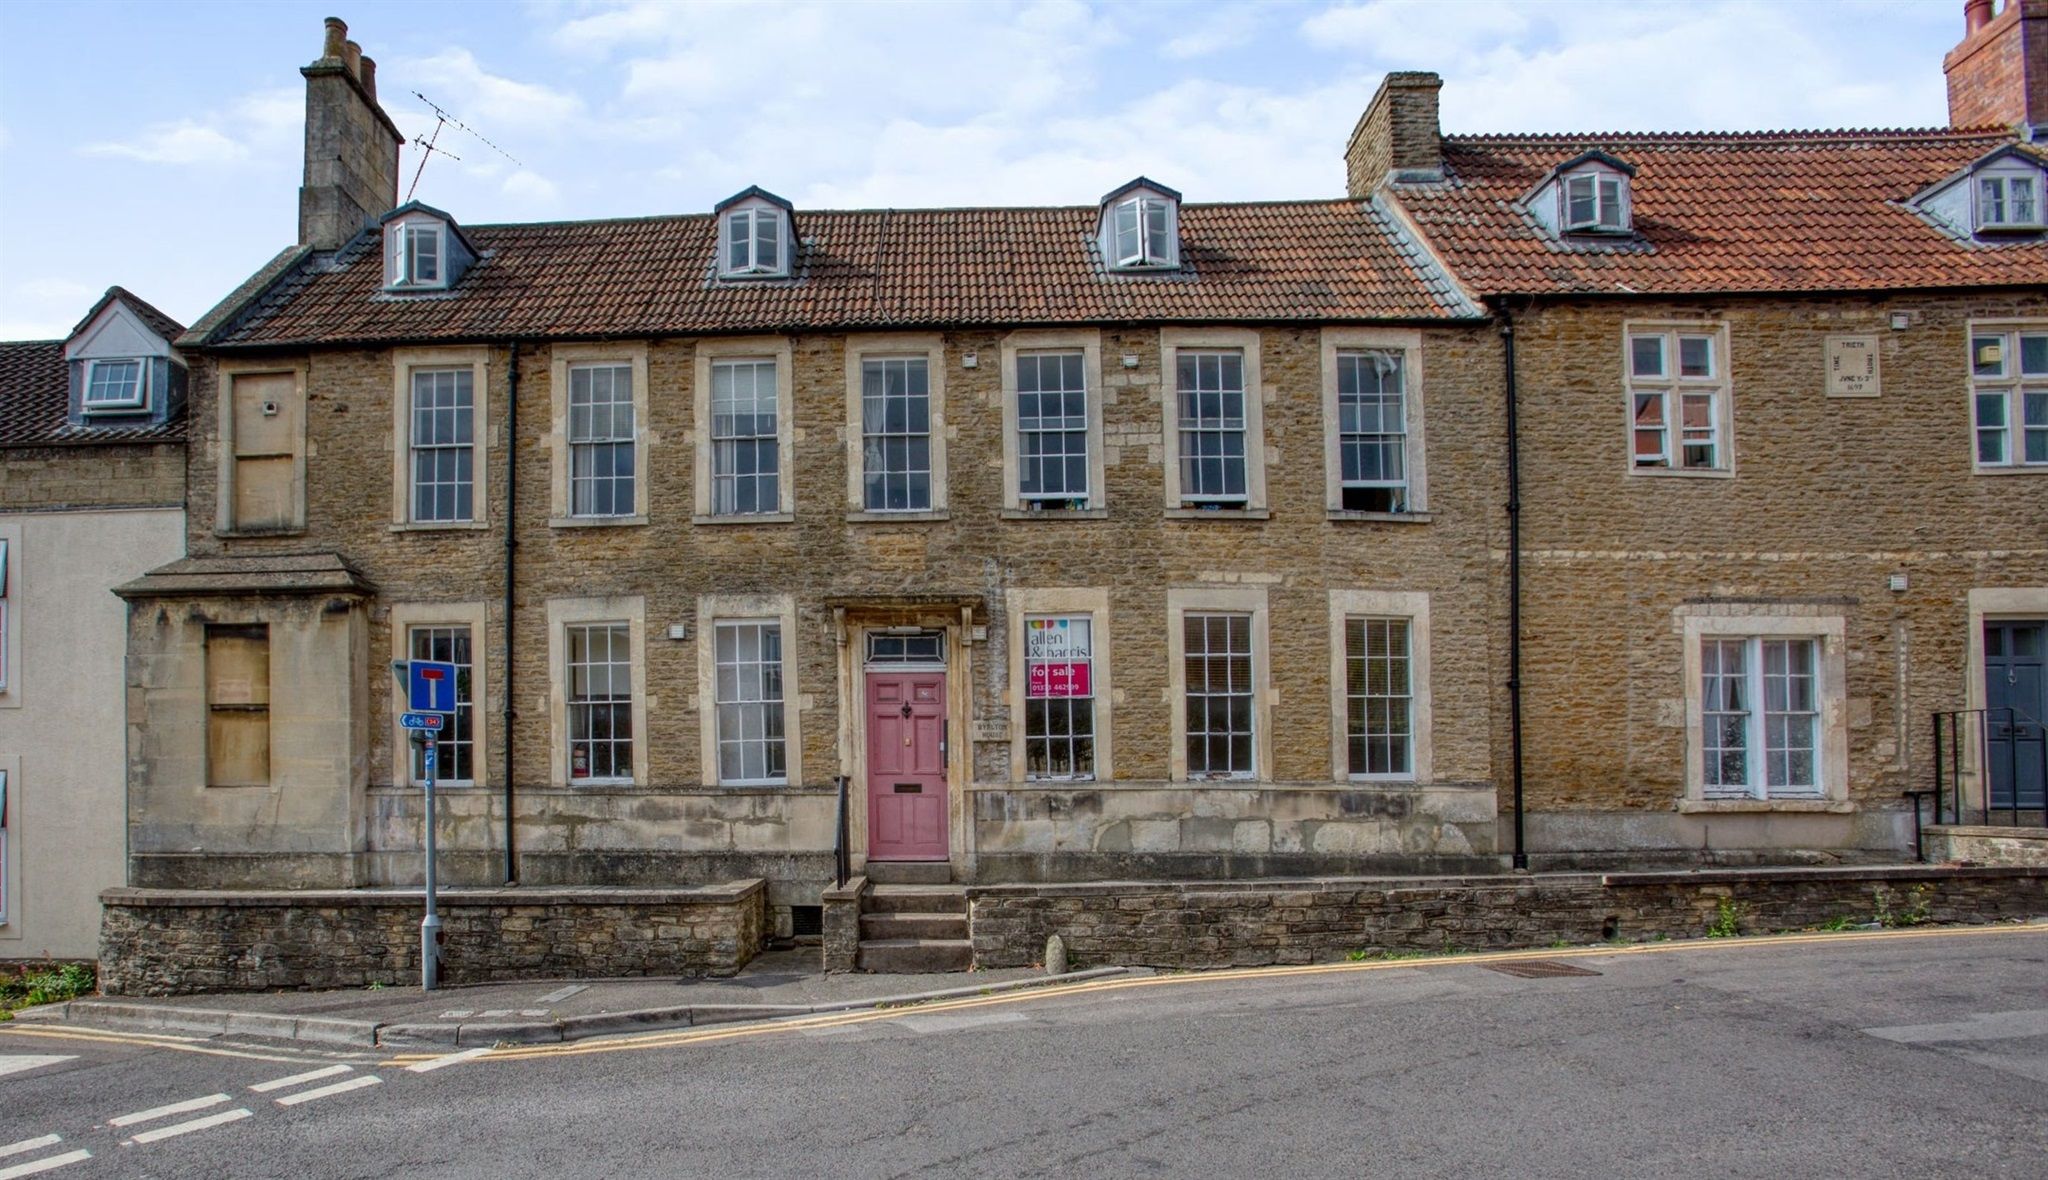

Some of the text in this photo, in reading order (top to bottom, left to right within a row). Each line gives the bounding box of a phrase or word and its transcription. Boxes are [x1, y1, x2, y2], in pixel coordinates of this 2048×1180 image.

[1031, 630, 1063, 645] allen
[1032, 645, 1088, 657] & harris
[1053, 666, 1076, 677] sale
